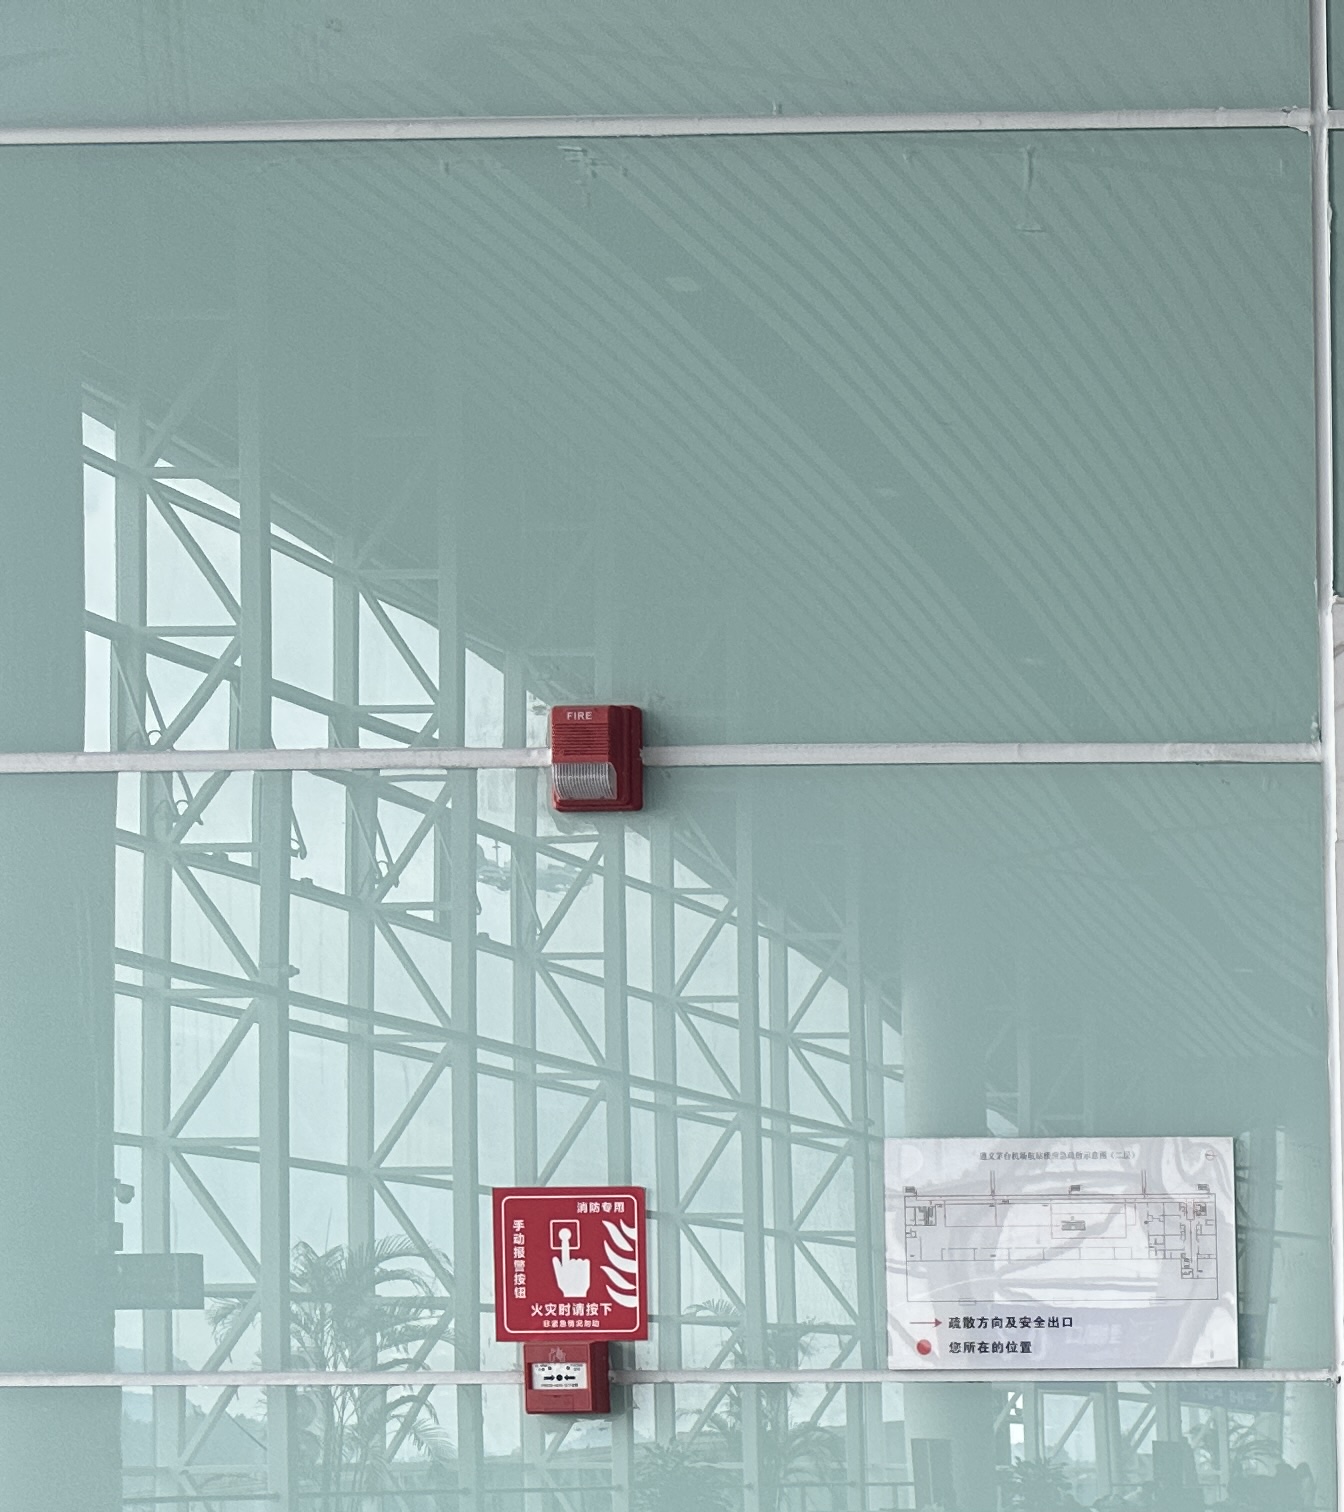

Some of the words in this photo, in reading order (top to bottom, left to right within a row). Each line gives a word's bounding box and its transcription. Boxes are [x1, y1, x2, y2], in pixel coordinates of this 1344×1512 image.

[566, 711, 593, 721] FIRE
[577, 1201, 625, 1214] 消防专用
[512, 1219, 527, 1299] 手动报警按钮
[530, 1302, 613, 1318] 火灾时请按下
[948, 1316, 1074, 1330] 疏散方向及安全出口
[949, 1340, 1033, 1354] 您所在的位置
